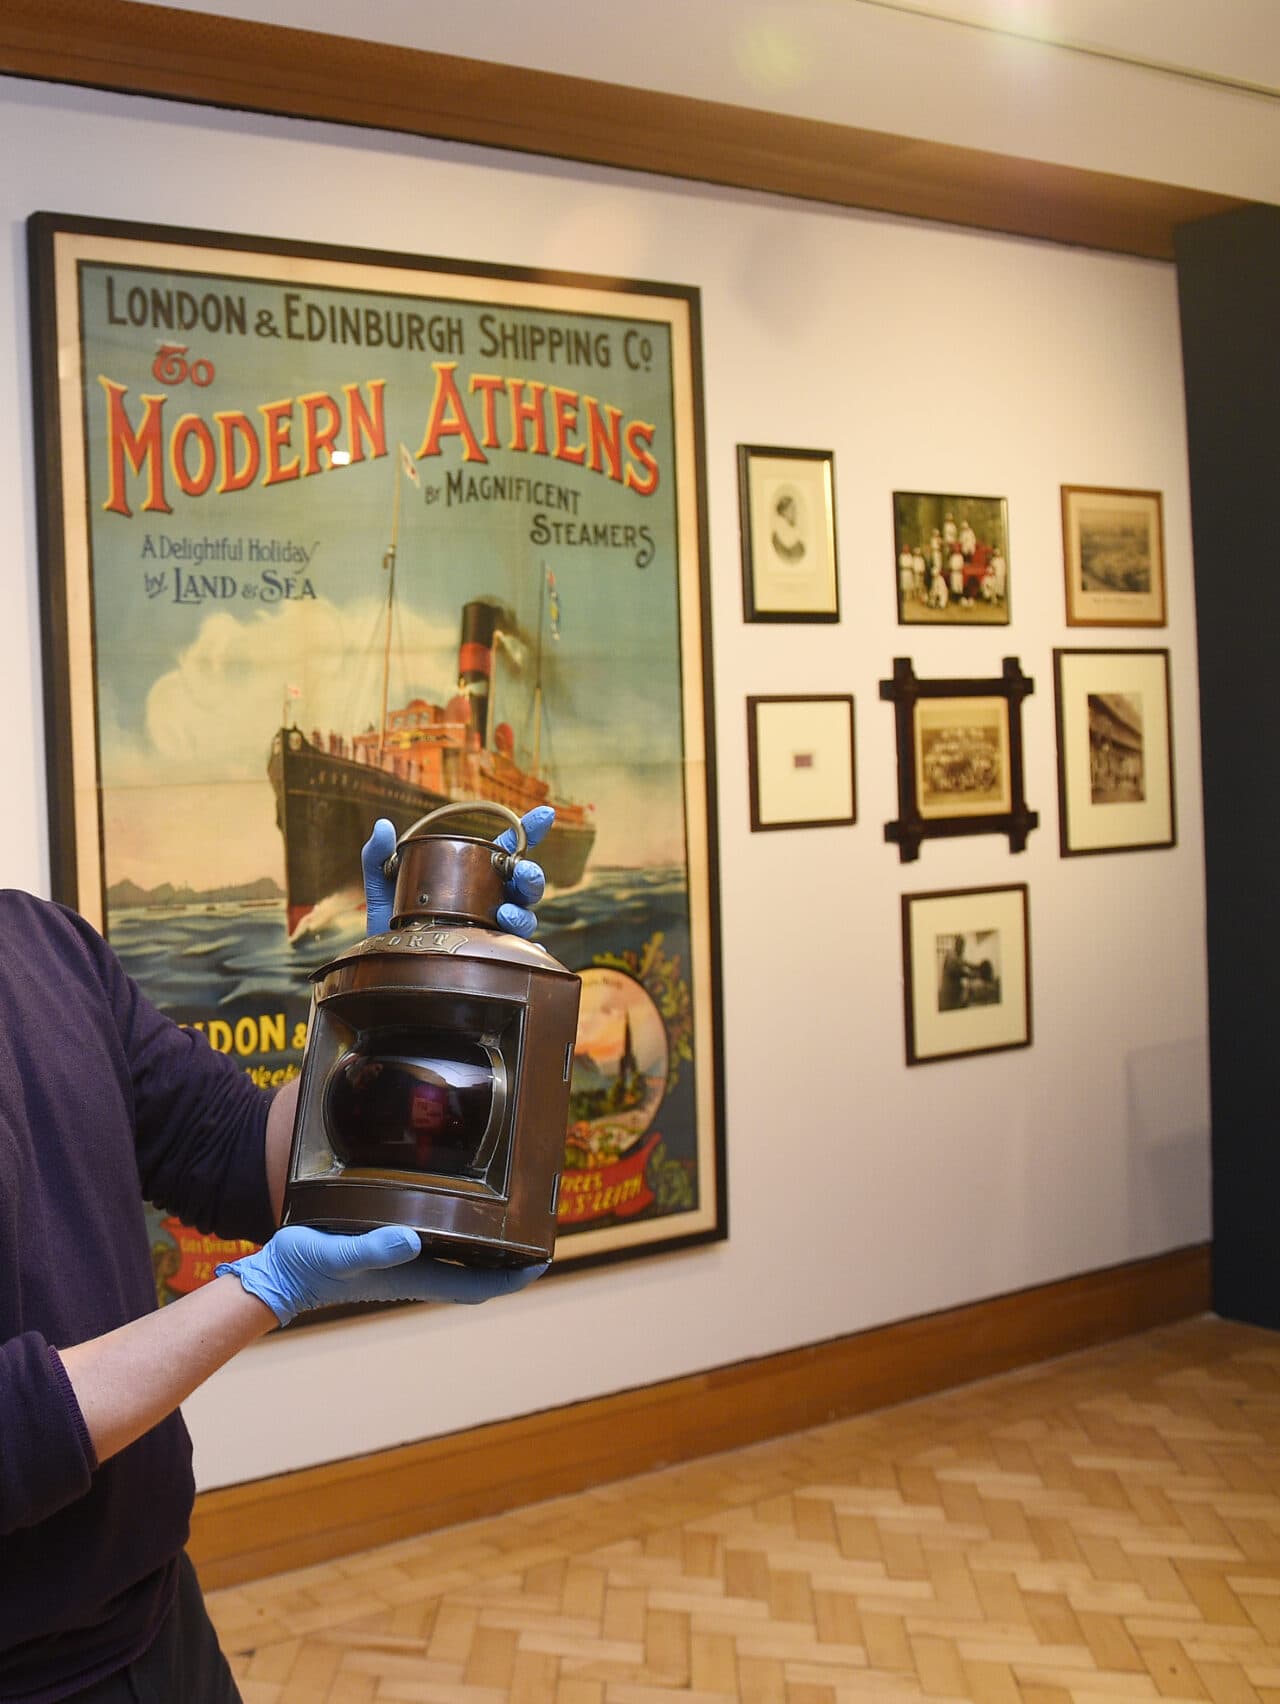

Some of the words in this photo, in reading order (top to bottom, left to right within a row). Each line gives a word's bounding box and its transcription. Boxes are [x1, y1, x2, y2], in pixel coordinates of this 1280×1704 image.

[106, 276, 248, 335] LONDON
[254, 308, 281, 339] &
[284, 292, 465, 355] EDINBURGH
[478, 313, 611, 369] SHIPPING
[151, 344, 216, 387] To
[98, 374, 389, 518] MODERN
[416, 361, 660, 497] ATHENS
[447, 469, 582, 516] MAGNIFICENT
[141, 534, 157, 560] A
[159, 534, 243, 566] Delightful
[248, 537, 321, 575] Holiday
[530, 513, 656, 569] STEAMERS
[173, 567, 239, 605] LAND
[259, 569, 318, 604] SEA
